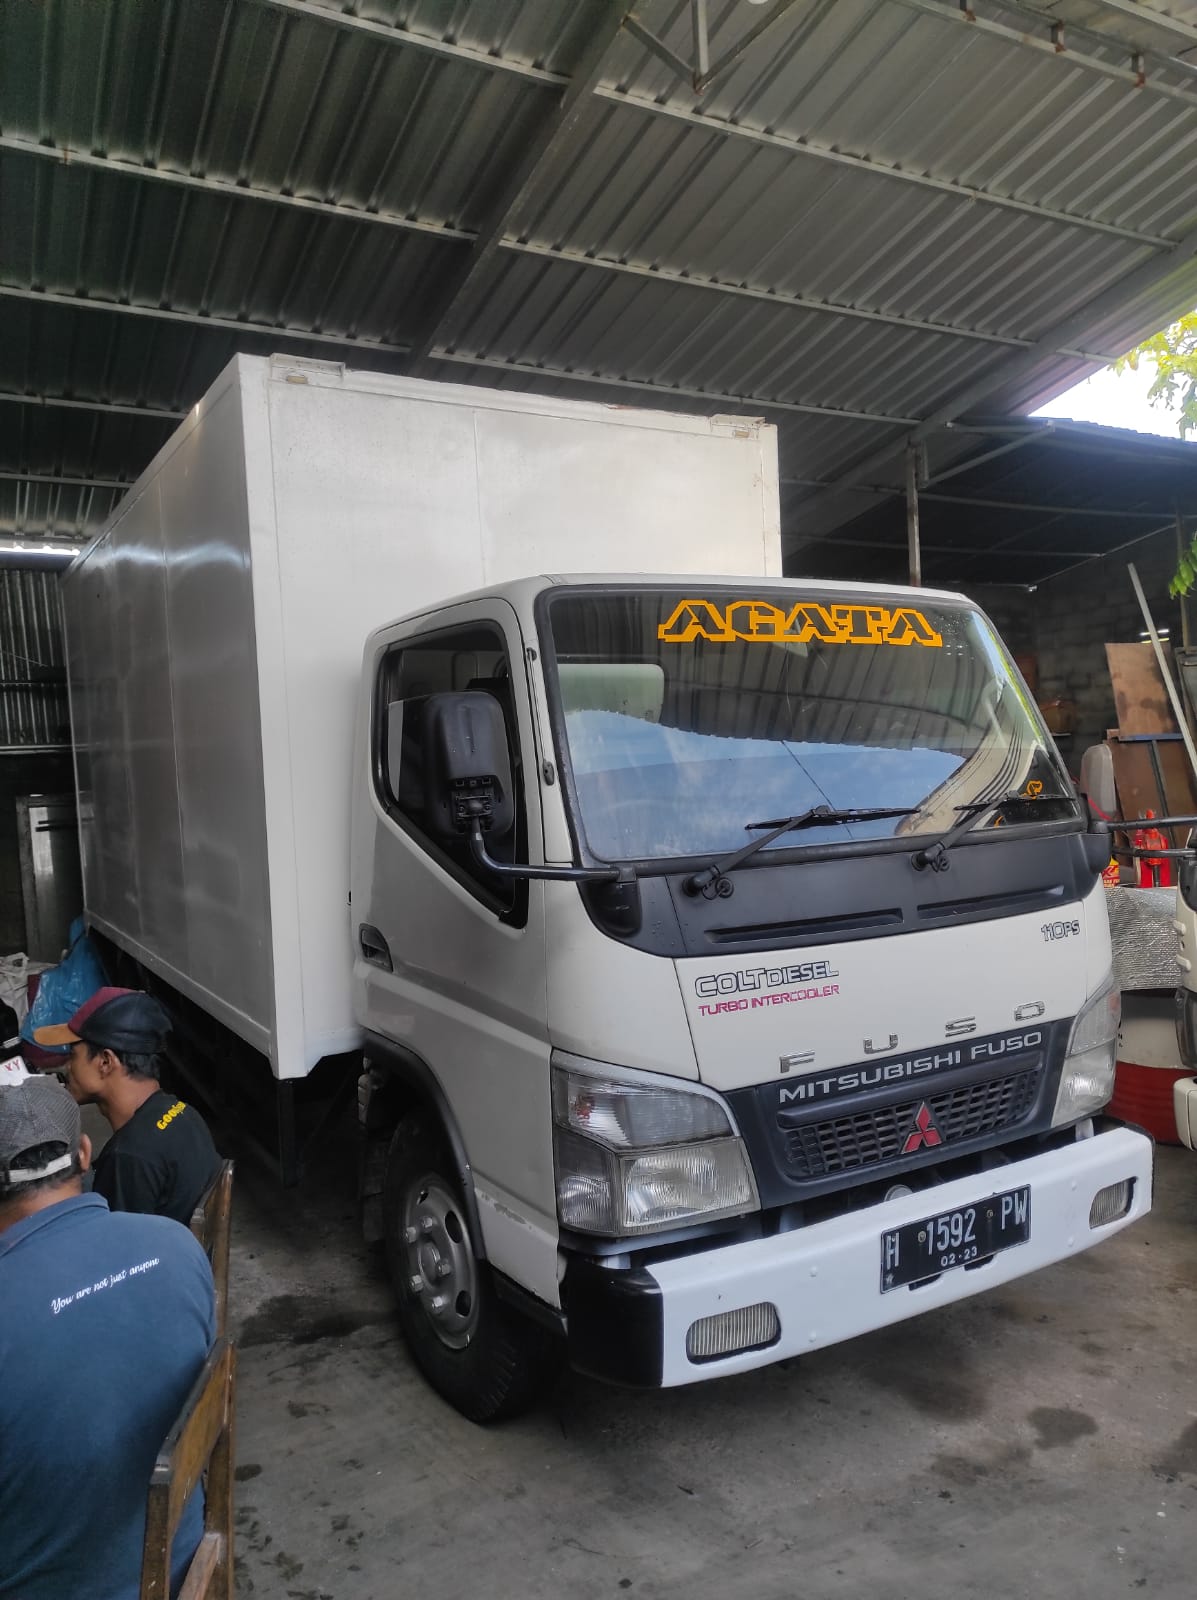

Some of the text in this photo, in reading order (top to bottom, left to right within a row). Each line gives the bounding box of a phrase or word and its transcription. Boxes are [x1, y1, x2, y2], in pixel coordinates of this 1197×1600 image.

[657, 599, 943, 647] AGATA
[1041, 919, 1080, 941] 110PS
[698, 984, 840, 1016] TURBO INTERCOOLER
[779, 1031, 1043, 1104] MITSUBISHI FUSO
[886, 1189, 1028, 1270] H 1592 PW
[51, 1297, 74, 1314] You
[76, 1287, 91, 1299] are
[94, 1278, 108, 1292] not
[110, 1270, 127, 1288] just
